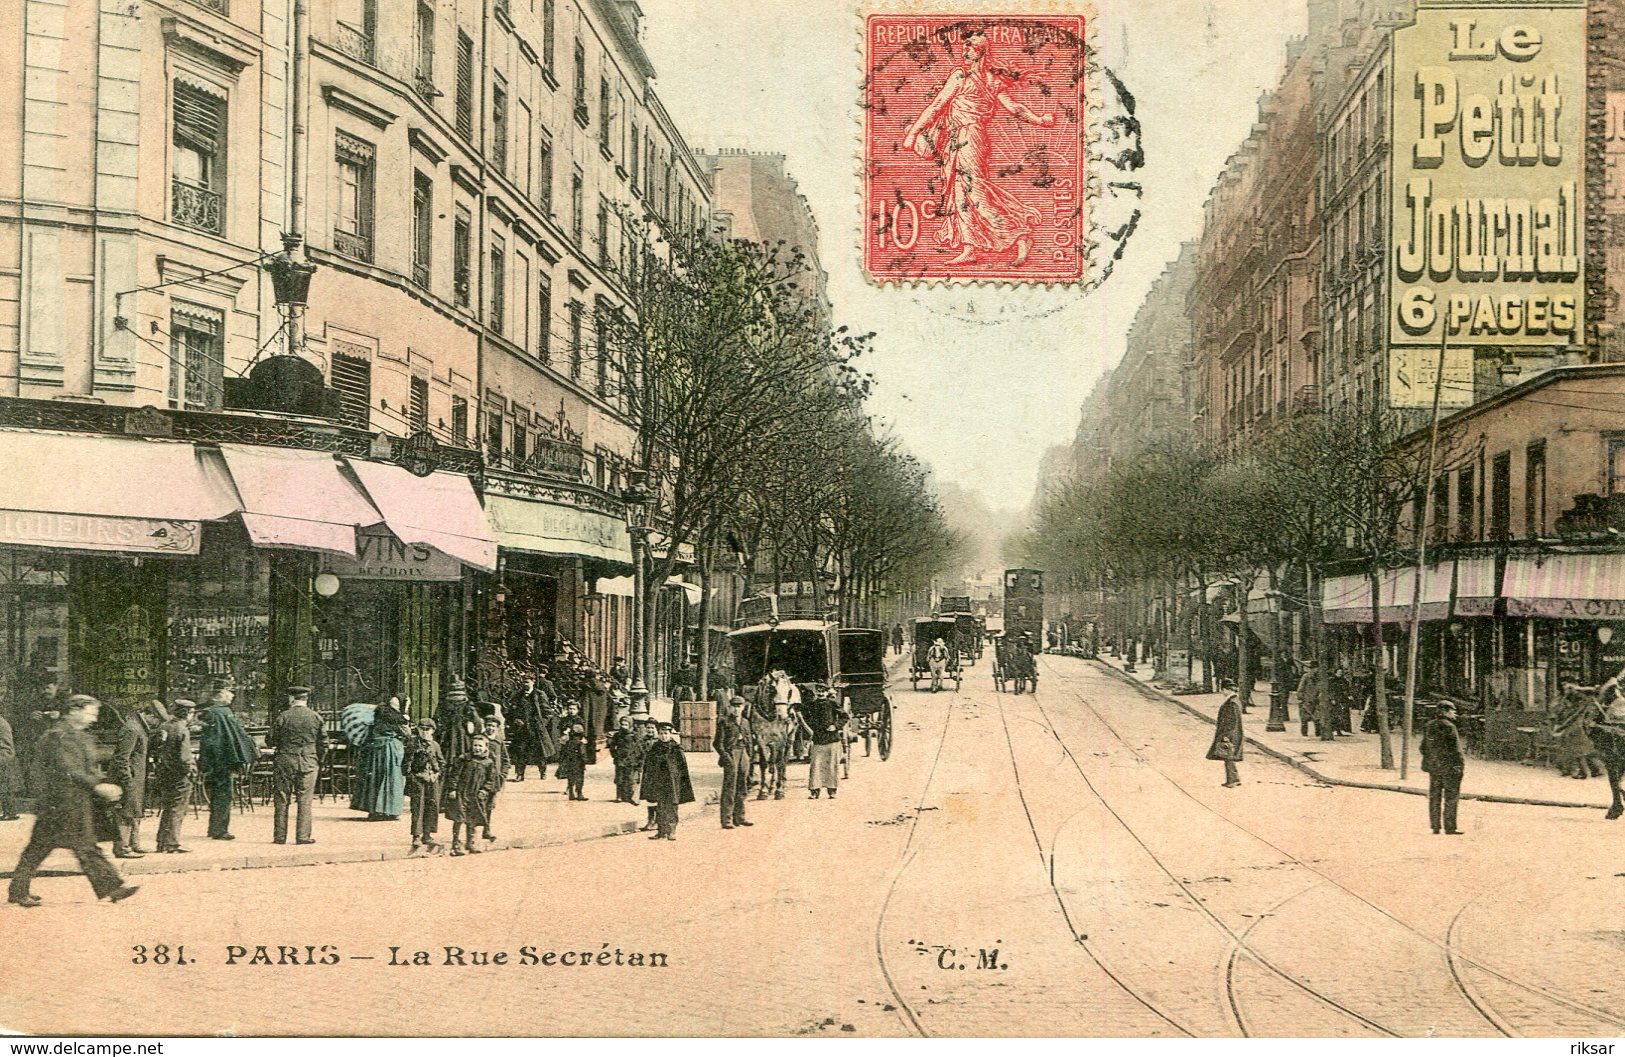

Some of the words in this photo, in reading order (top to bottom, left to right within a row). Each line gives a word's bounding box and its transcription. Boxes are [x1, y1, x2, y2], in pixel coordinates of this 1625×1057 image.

[1448, 18, 1543, 62] Le
[1413, 66, 1563, 169] Petit
[1053, 178, 1073, 263] POSTES
[1397, 177, 1579, 284] Journal
[1398, 285, 1437, 337] 6
[1448, 294, 1577, 337] PAGES
[355, 538, 431, 562] VINS
[1559, 639, 1581, 654] 20
